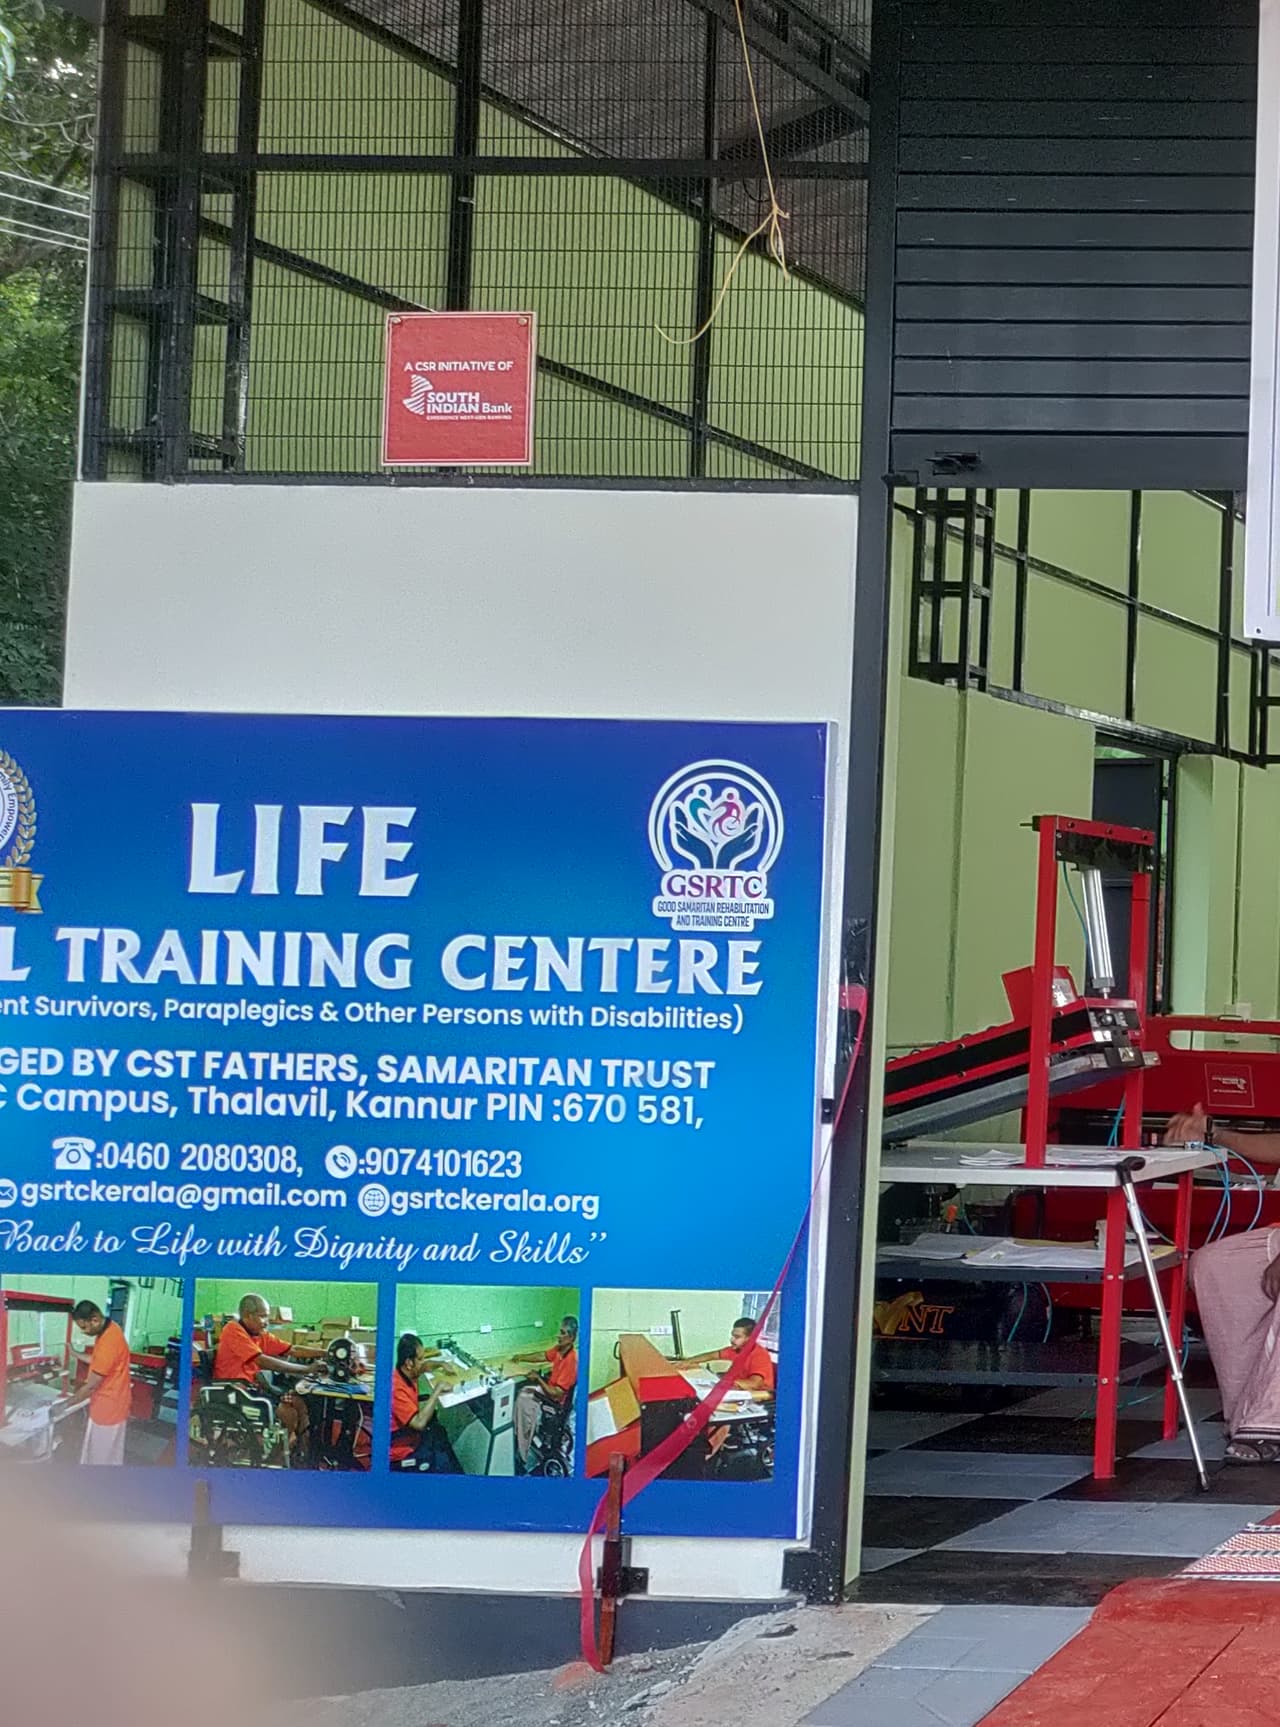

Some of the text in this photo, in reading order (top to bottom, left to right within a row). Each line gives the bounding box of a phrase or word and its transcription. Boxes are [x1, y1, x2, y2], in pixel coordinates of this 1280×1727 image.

[404, 361, 513, 371] A CSR INITIATIVE OF
[427, 392, 480, 402] SOUTH
[427, 403, 512, 413] INDIAN Bank
[188, 803, 420, 897] LIFE
[666, 874, 763, 898] GSRTC
[657, 901, 770, 915] GOOD SAMARITAN REHABILITATION
[676, 915, 750, 928] AND TRAINING CENTRE
[56, 926, 764, 996] TRAINING CENTERE
[35, 996, 743, 1034] Survivors, Paraplegics & Other Persons with Disabilities)
[72, 1049, 120, 1077] BY
[126, 1050, 197, 1079] CST
[204, 1052, 369, 1086] FATHERS,
[377, 1055, 592, 1087] SAMARITAN
[601, 1060, 716, 1089] TRUST
[17, 1083, 178, 1121] Campus,
[187, 1086, 337, 1121] Thalavil,
[346, 1090, 477, 1120] Kannur
[486, 1092, 543, 1122] PIN
[553, 1094, 626, 1124] :670
[638, 1096, 703, 1130] 581,
[96, 1142, 522, 1178] :0460 2080308, :9074101623
[21, 1180, 600, 1220] gsrtckerala@gmail.com gsrtckerala.org
[0, 1218, 89, 1253] Back
[93, 1229, 126, 1253] to
[132, 1222, 211, 1266] Life
[217, 1226, 287, 1258] with
[294, 1225, 419, 1272] Dignity
[423, 1232, 481, 1262] and
